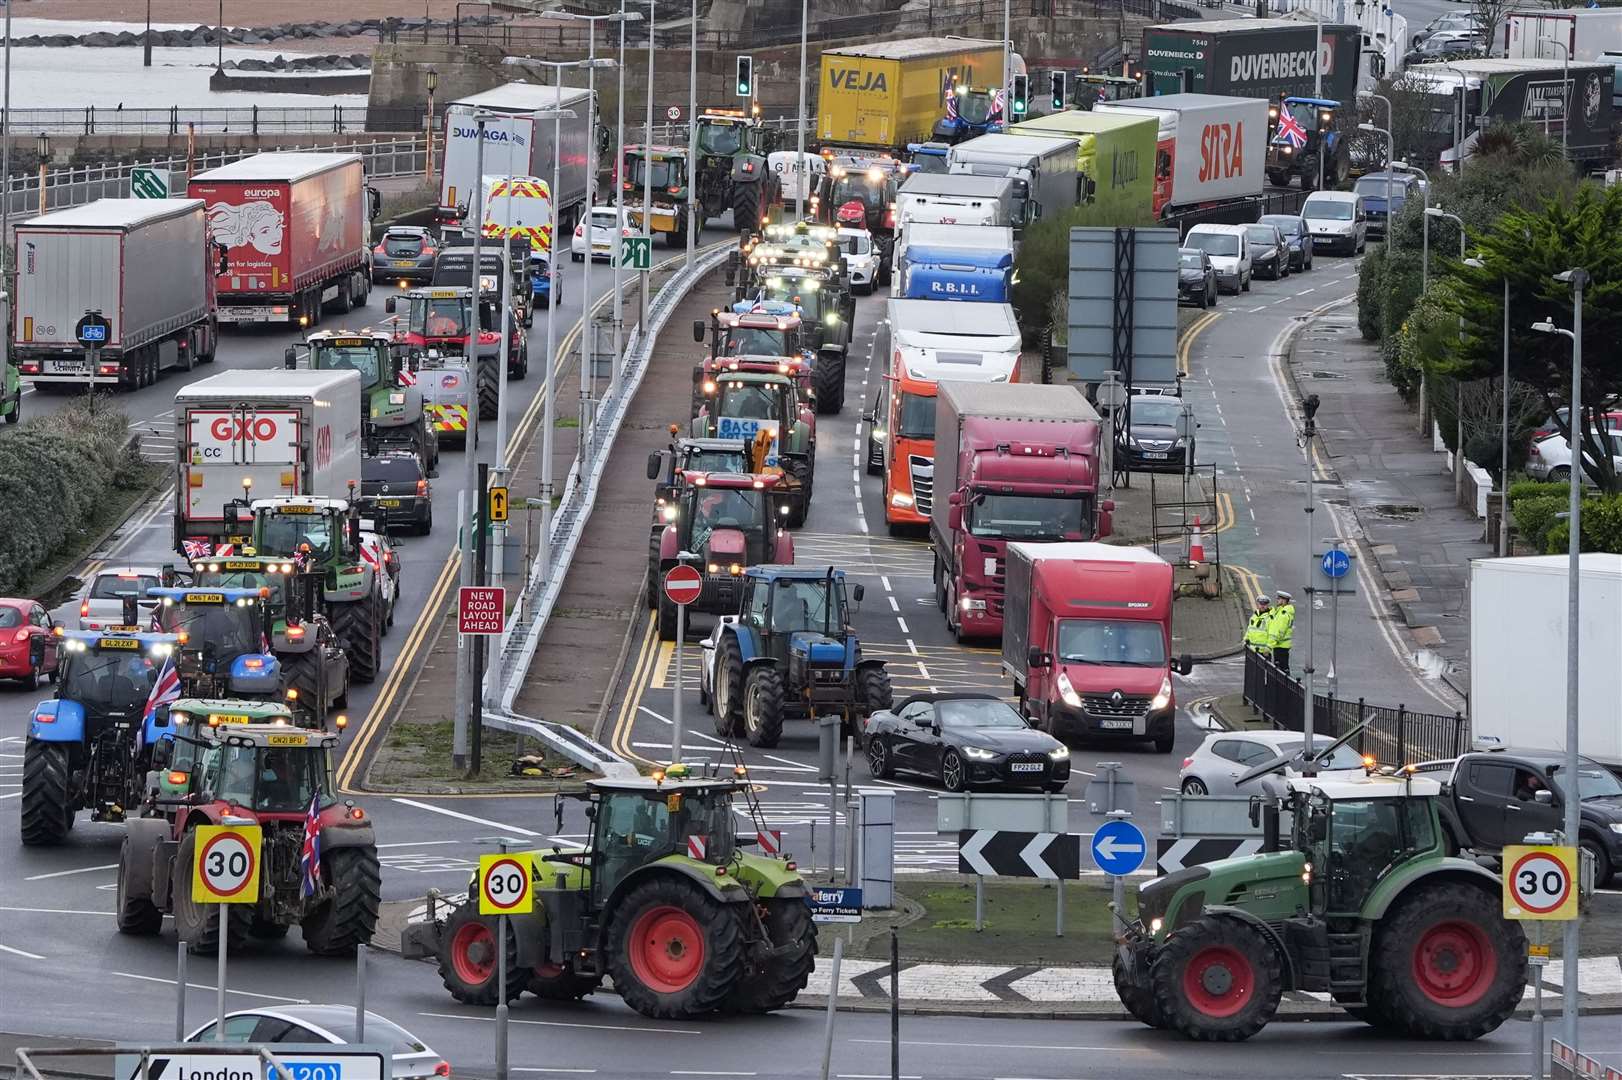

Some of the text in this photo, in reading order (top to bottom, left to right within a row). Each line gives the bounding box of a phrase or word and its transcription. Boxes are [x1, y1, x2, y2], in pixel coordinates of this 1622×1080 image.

[1148, 49, 1196, 60] DUVENBECK
[1230, 50, 1316, 82] DUVENBECK
[829, 68, 887, 92] VEJA
[669, 109, 679, 117] 30
[453, 127, 516, 142] DUMAGA
[244, 188, 280, 198] europa
[246, 261, 272, 269] logistics
[210, 417, 277, 442] GXO
[204, 447, 222, 457] CC
[316, 424, 331, 471] GXO
[471, 591, 494, 600] NEW
[467, 601, 496, 610] ROAD
[463, 611, 501, 620] LAYOUT
[463, 621, 498, 630] AHEAD
[207, 851, 247, 877] 30
[490, 874, 521, 894] 30
[1519, 870, 1563, 895] 30
[179, 1067, 253, 1080] London
